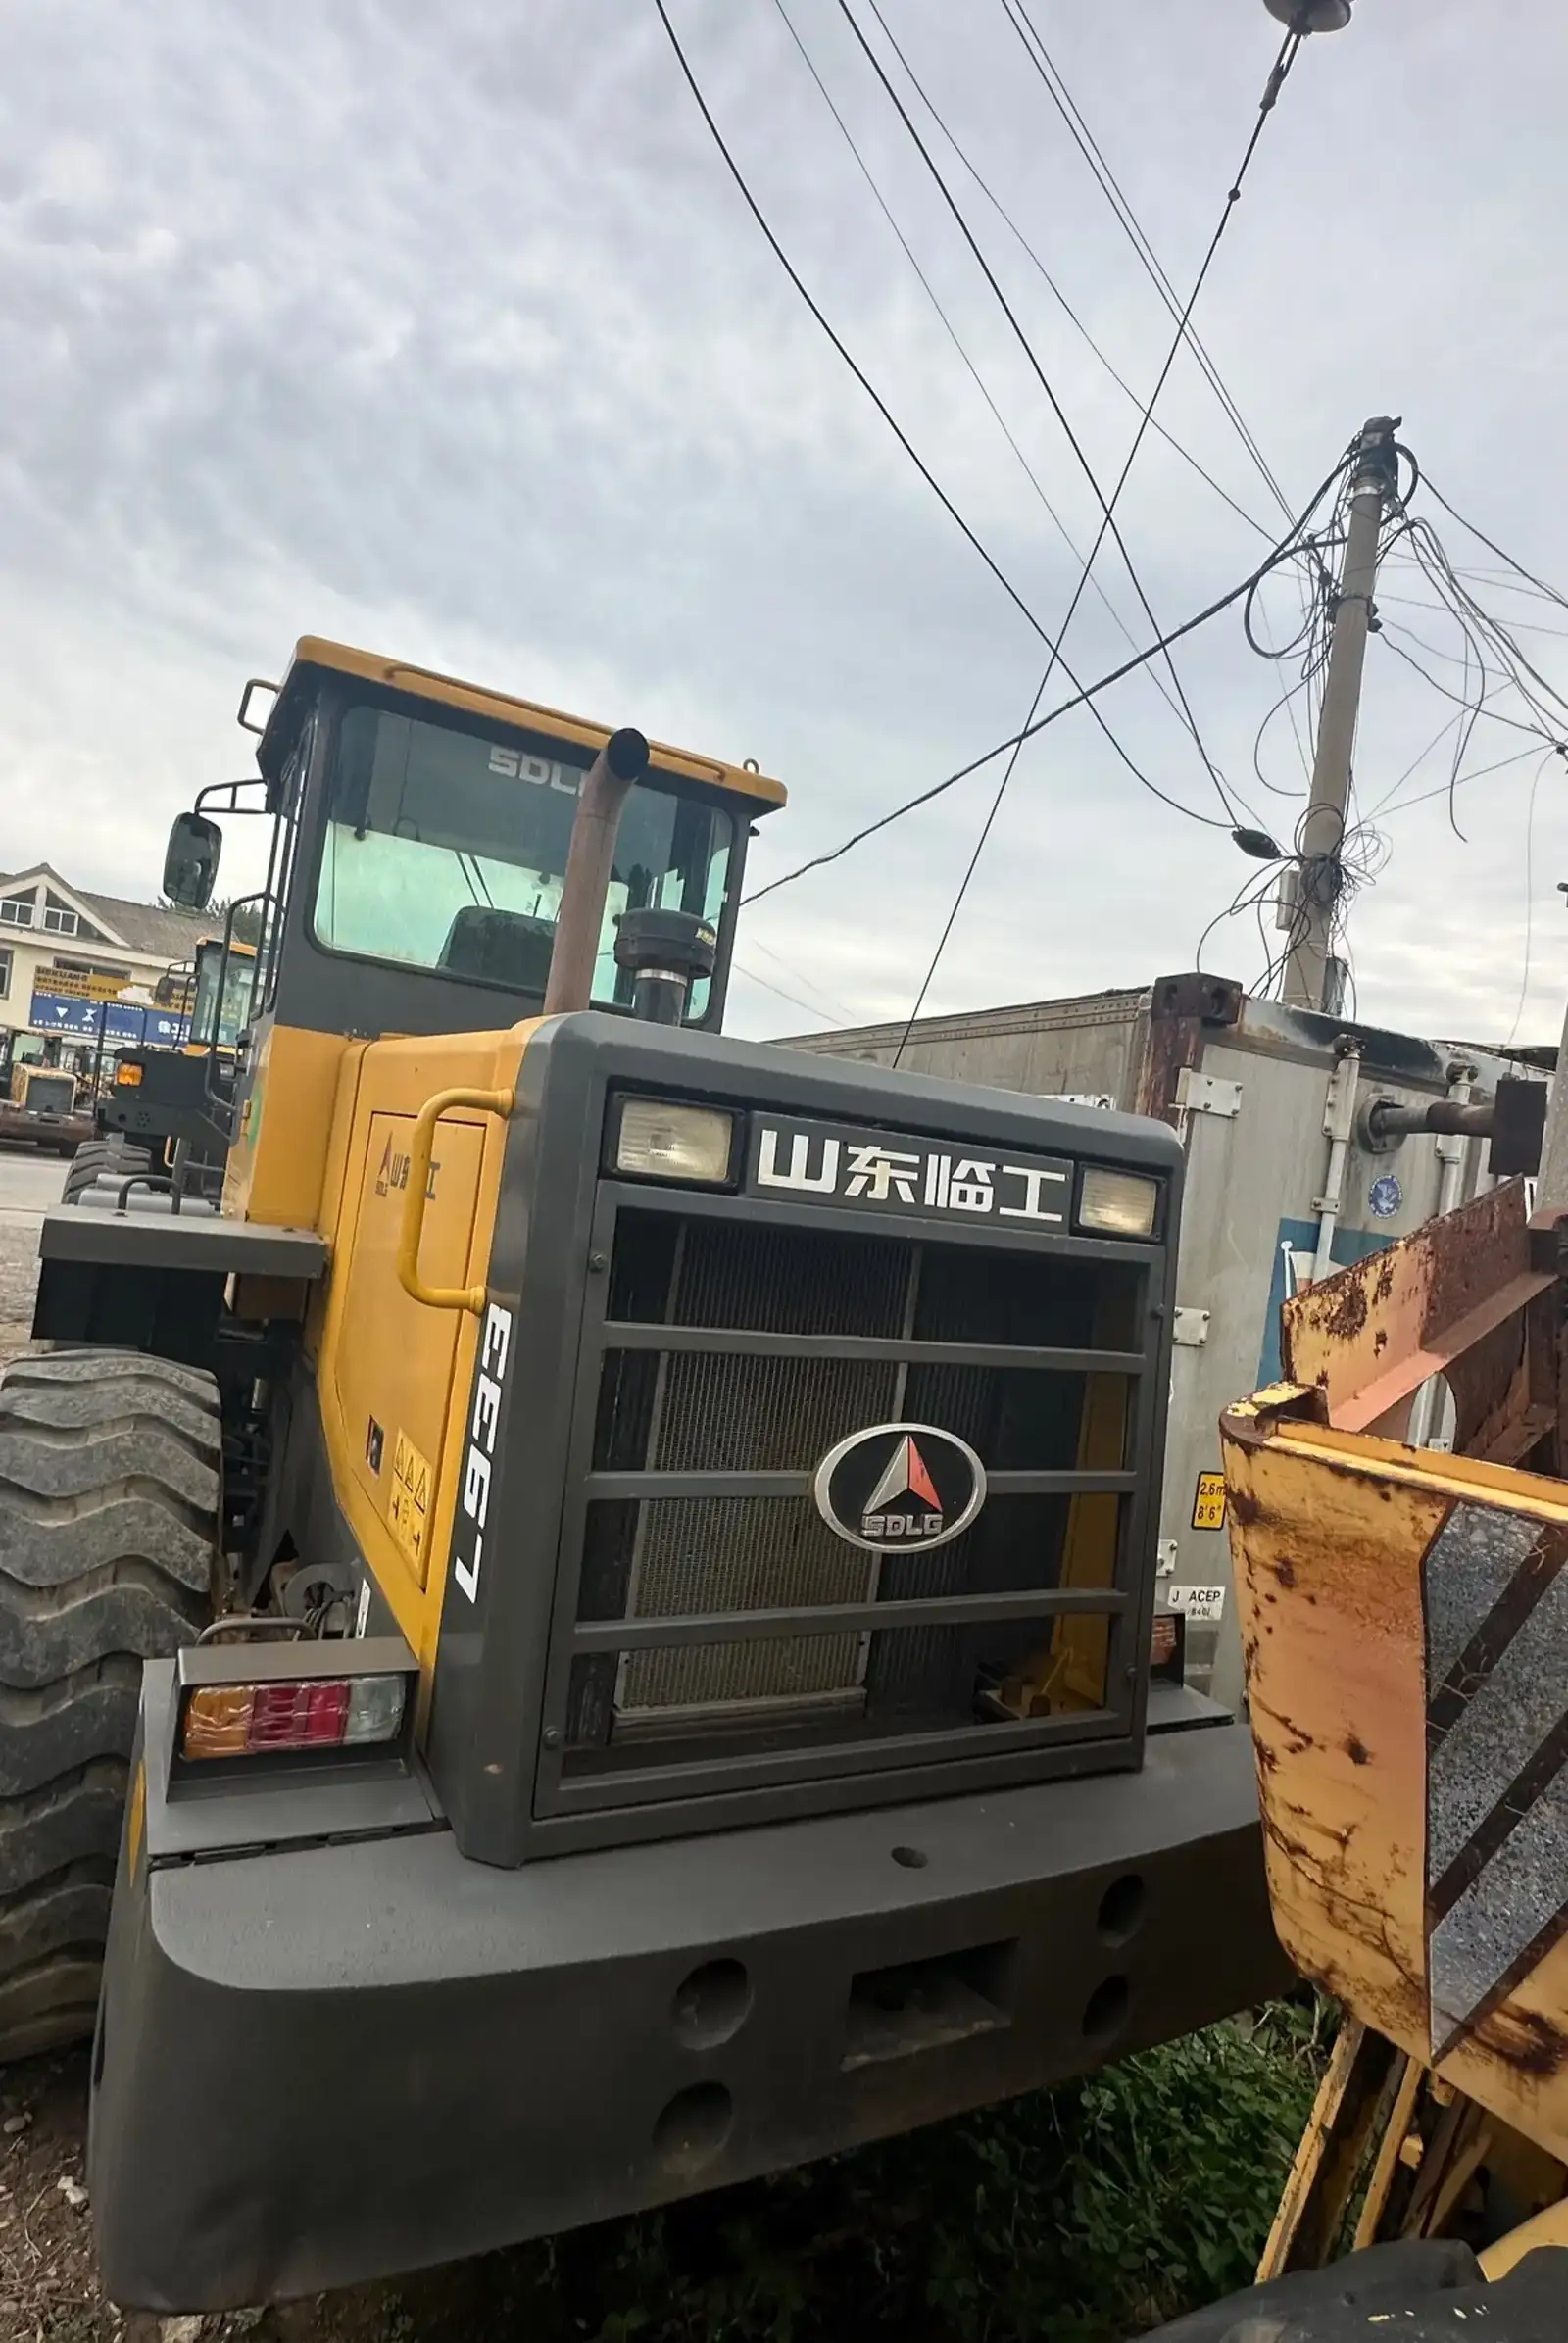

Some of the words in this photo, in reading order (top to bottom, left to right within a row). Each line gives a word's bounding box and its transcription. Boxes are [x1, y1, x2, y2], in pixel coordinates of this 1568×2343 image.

[390, 1151, 441, 1201] 山东工
[758, 1129, 1066, 1222] 山东临工
[454, 1302, 513, 1604] L933
[861, 1513, 944, 1537] SDLG
[1188, 1589, 1221, 1603] ACEP
